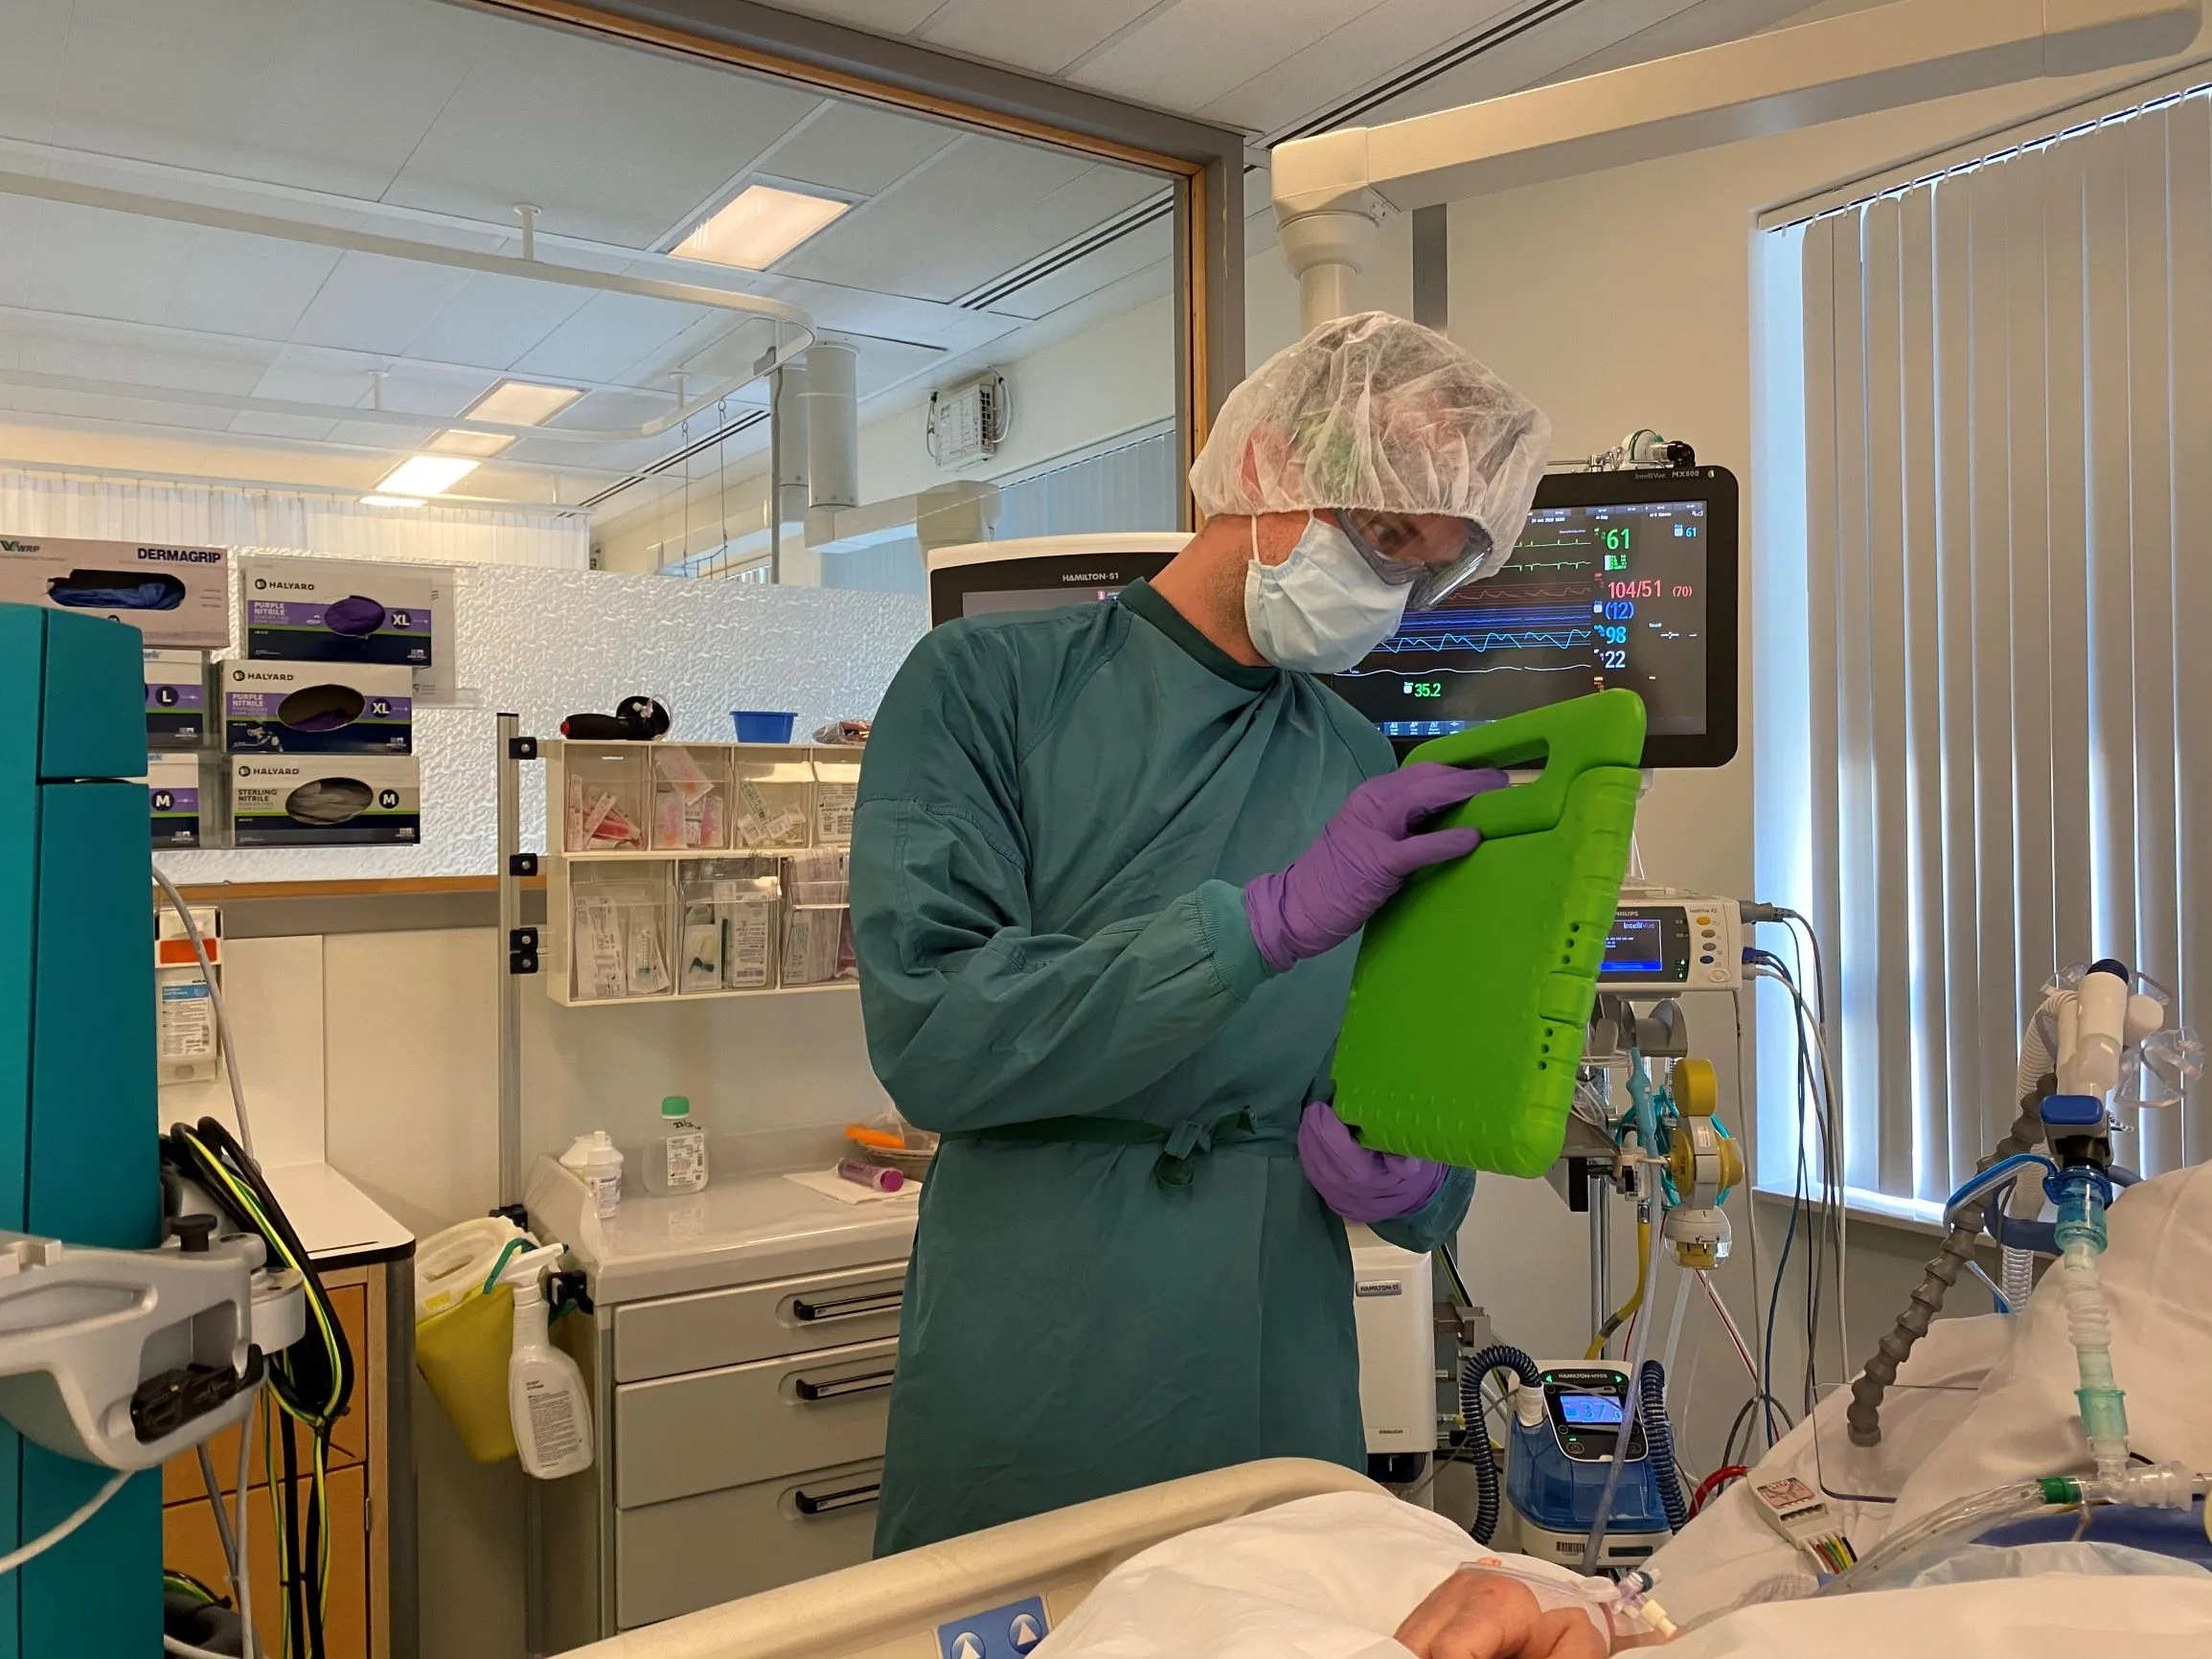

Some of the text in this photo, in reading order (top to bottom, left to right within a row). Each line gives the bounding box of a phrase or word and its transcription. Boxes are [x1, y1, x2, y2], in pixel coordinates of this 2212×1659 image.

[1685, 528, 1698, 537] 61
[1607, 528, 1630, 550] 61
[137, 548, 221, 564] DERMAGRIP
[1062, 573, 1119, 582] HAMILTON-S1
[269, 581, 315, 591] HALYARD
[1608, 580, 1693, 599] 104/51 (70)
[1605, 602, 1634, 620] (12)
[392, 614, 410, 626] XL
[1606, 626, 1627, 644] 98
[1605, 650, 1626, 669] 22
[1414, 683, 1441, 697] 35.2
[162, 691, 172, 703] L
[373, 703, 390, 715] XL
[155, 795, 171, 807] M
[382, 794, 396, 806] M
